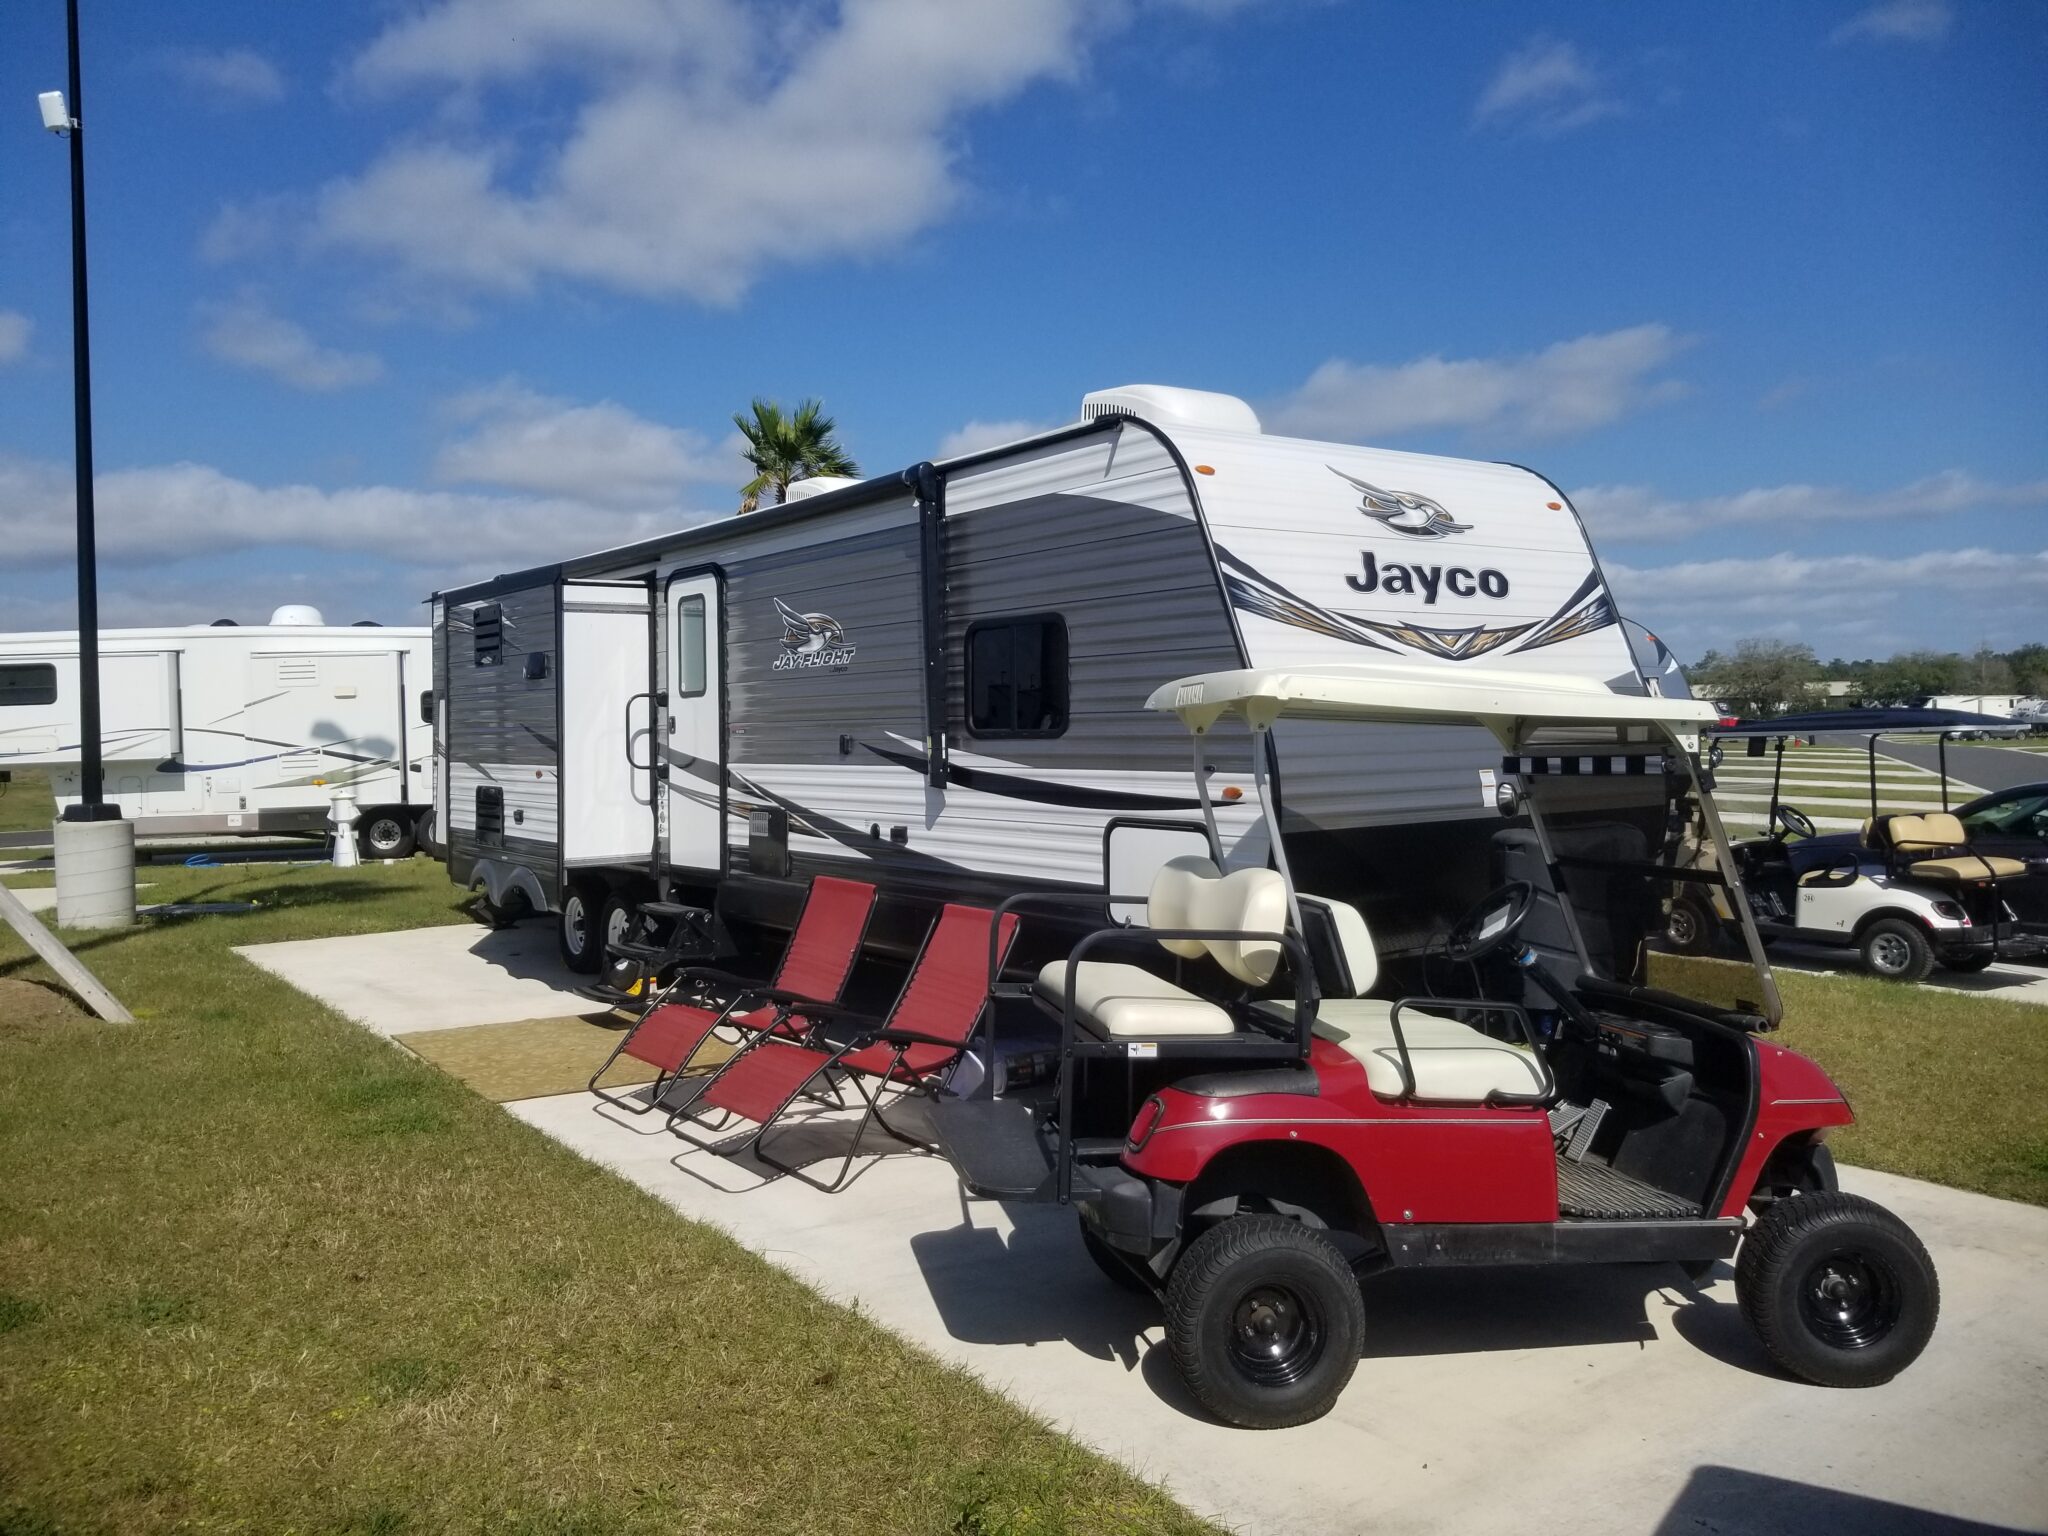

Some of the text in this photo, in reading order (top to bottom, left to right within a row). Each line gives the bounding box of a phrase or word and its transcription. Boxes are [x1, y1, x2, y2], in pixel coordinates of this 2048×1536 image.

[1345, 550, 1509, 605] Jayco
[773, 647, 856, 671] JAY FLIGHT
